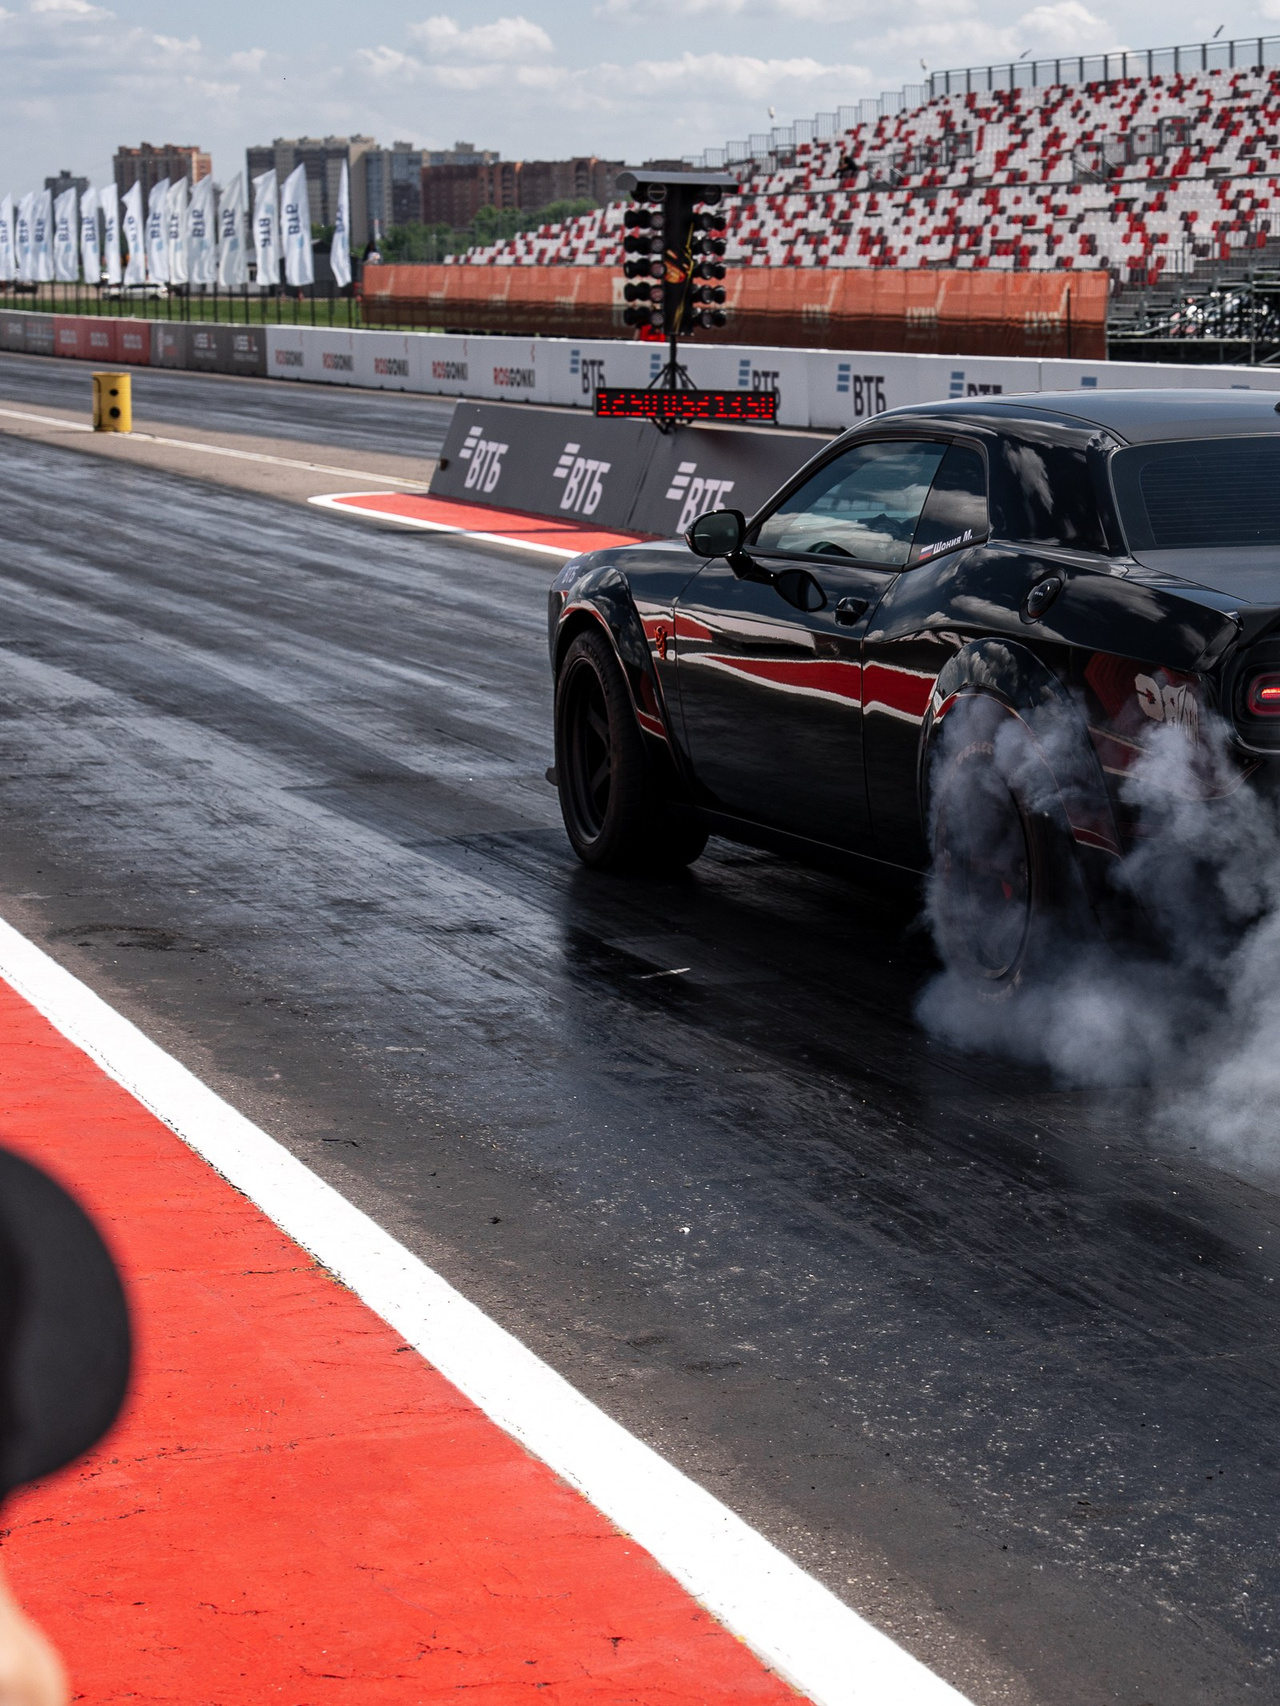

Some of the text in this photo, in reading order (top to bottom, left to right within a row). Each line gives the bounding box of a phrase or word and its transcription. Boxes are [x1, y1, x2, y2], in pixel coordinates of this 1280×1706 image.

[853, 375, 886, 417] ВТБ
[464, 439, 509, 493] ВТБ
[560, 457, 611, 515] ВТБ
[933, 528, 973, 554] Шония М.
[561, 565, 579, 584] ВТБ
